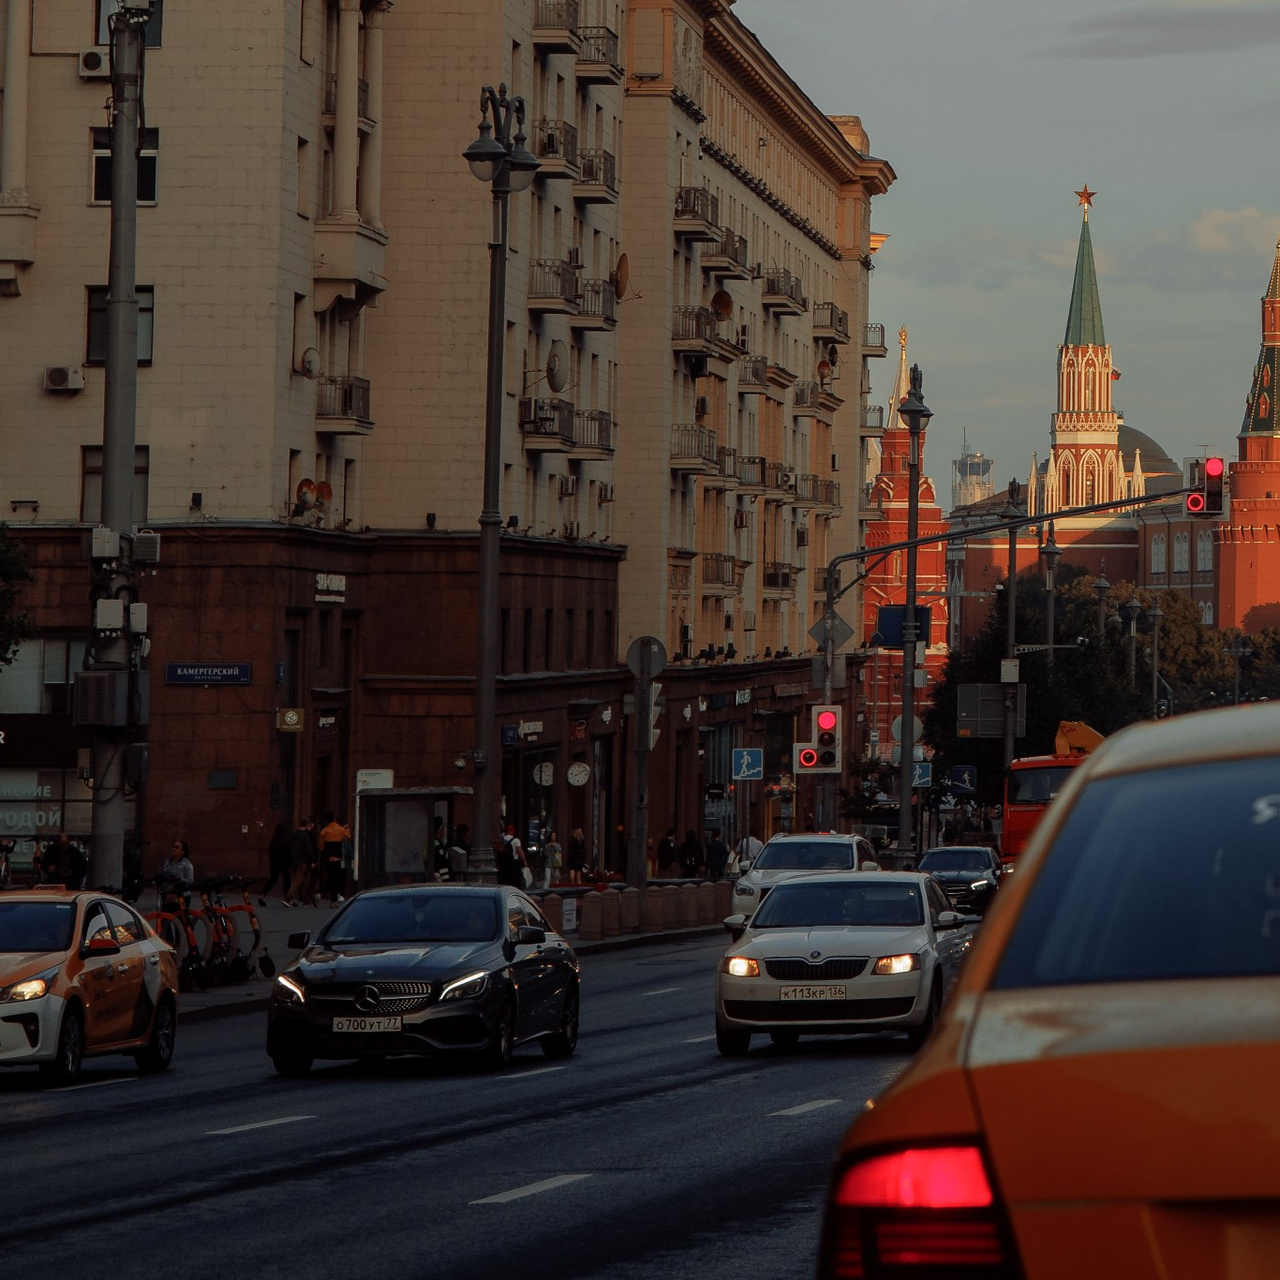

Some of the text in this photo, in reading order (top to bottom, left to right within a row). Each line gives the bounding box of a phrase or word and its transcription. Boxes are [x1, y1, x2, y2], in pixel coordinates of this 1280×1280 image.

[177, 666, 239, 676] КАМЕРГЕРСКИЙ
[783, 987, 843, 999] К113КР 136
[336, 1018, 398, 1030] О700УТ 77
